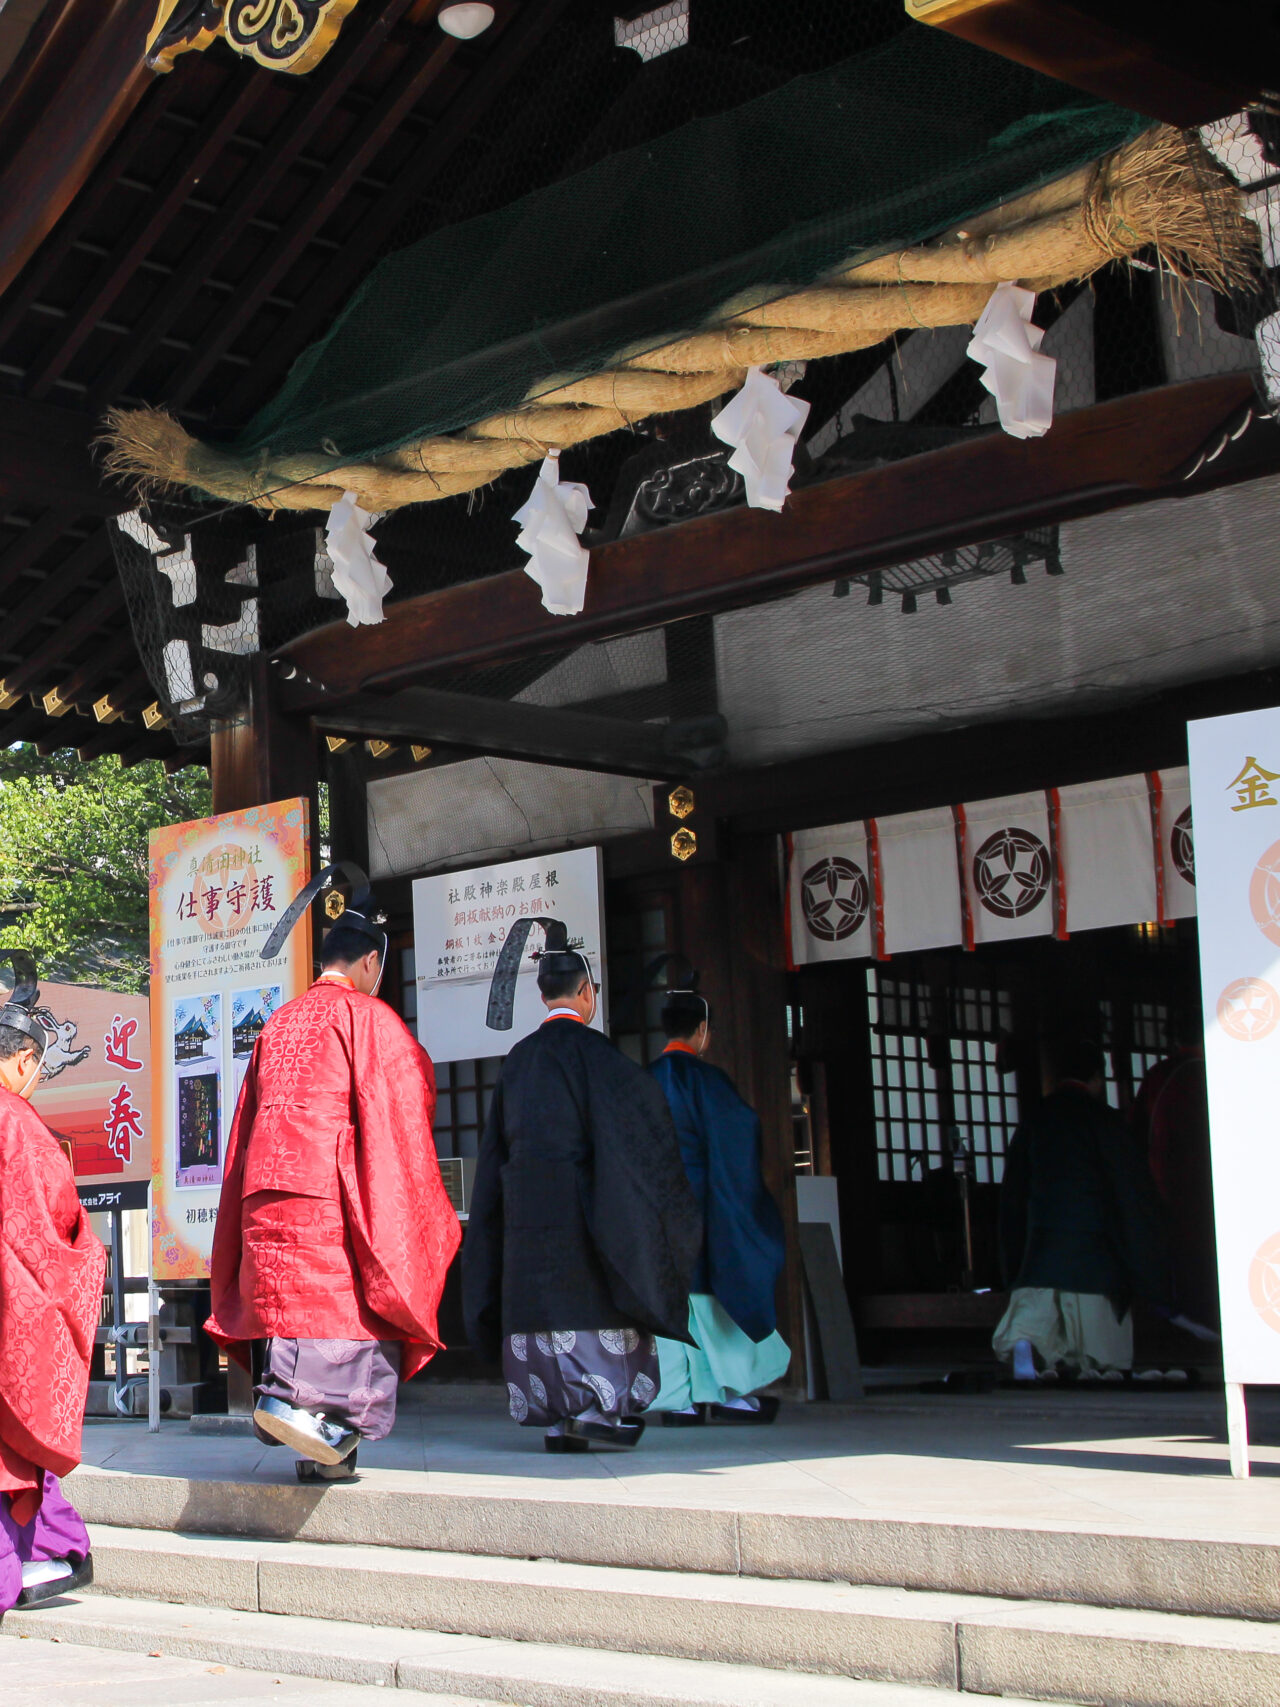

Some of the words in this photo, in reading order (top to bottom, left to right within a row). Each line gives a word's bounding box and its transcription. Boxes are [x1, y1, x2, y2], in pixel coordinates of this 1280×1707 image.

[1224, 756, 1280, 812] 金
[176, 875, 276, 922] 仕事守護
[448, 870, 559, 904] 社殿神楽殿屋根
[454, 898, 556, 927] 銅板献納のお願い
[105, 1014, 145, 1163] 迎春
